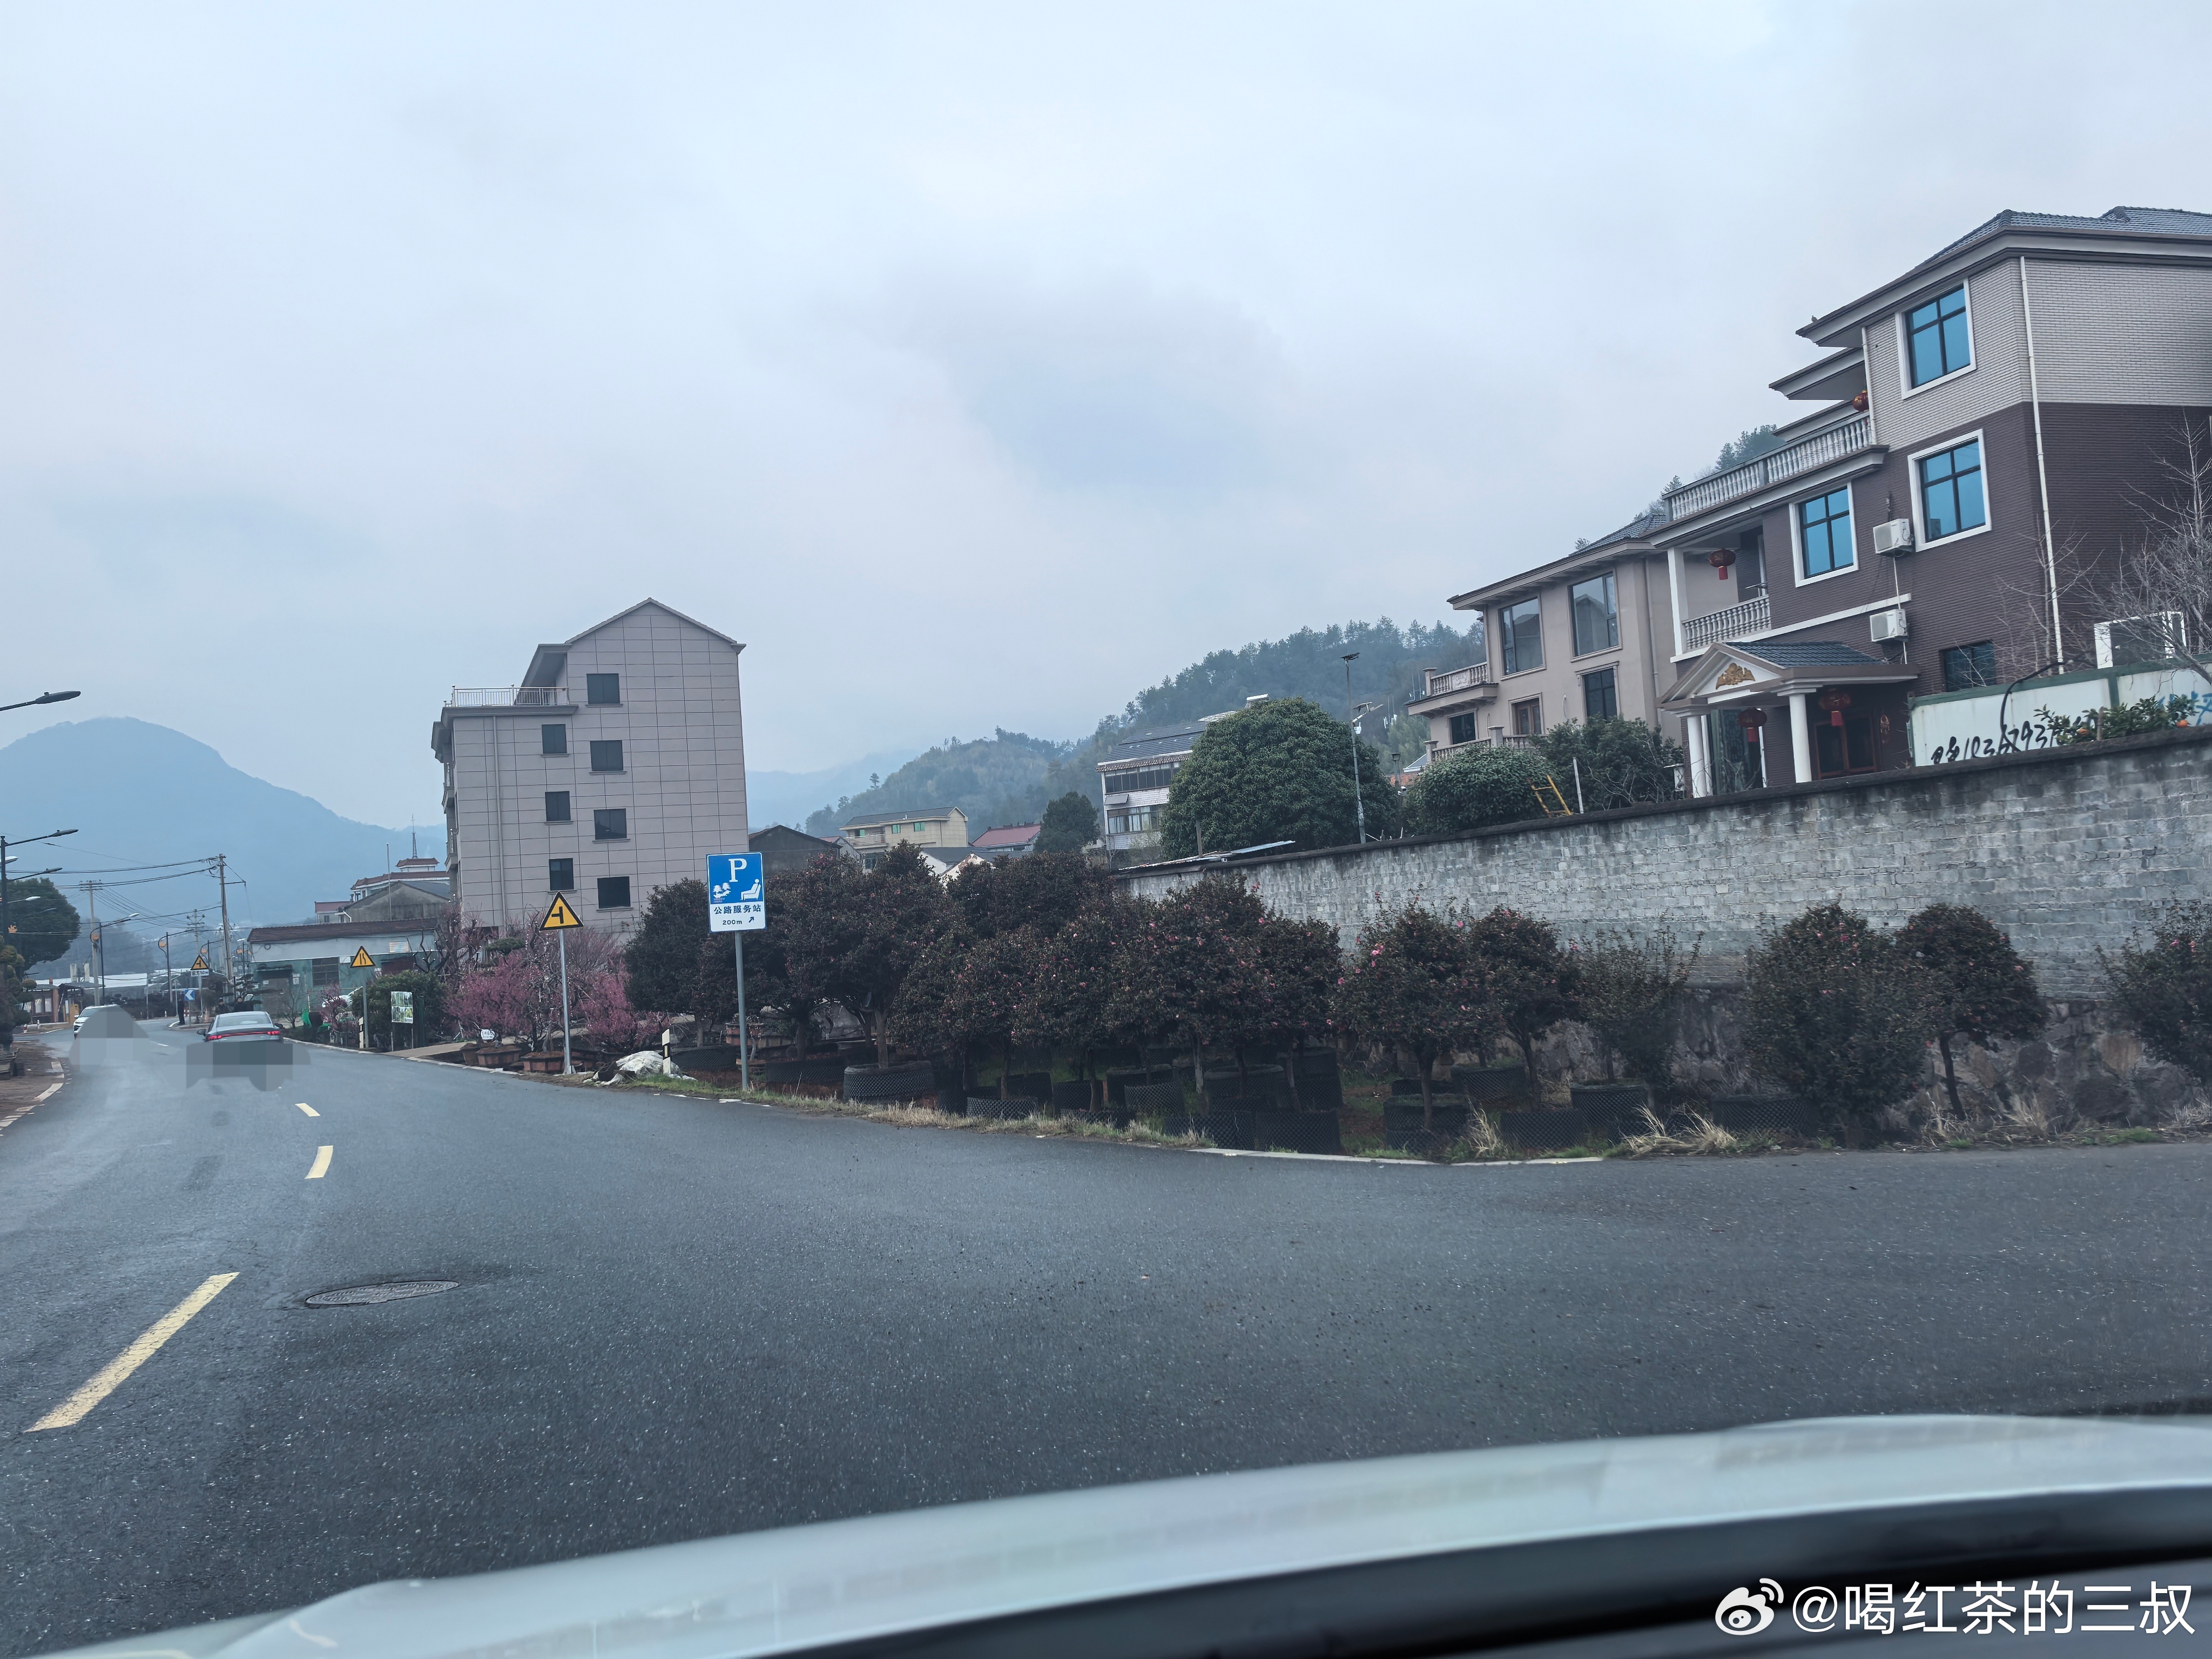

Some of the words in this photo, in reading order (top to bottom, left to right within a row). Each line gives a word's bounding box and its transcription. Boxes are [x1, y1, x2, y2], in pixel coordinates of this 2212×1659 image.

[729, 858, 747, 882] P
[714, 904, 761, 914] 公路服务站
